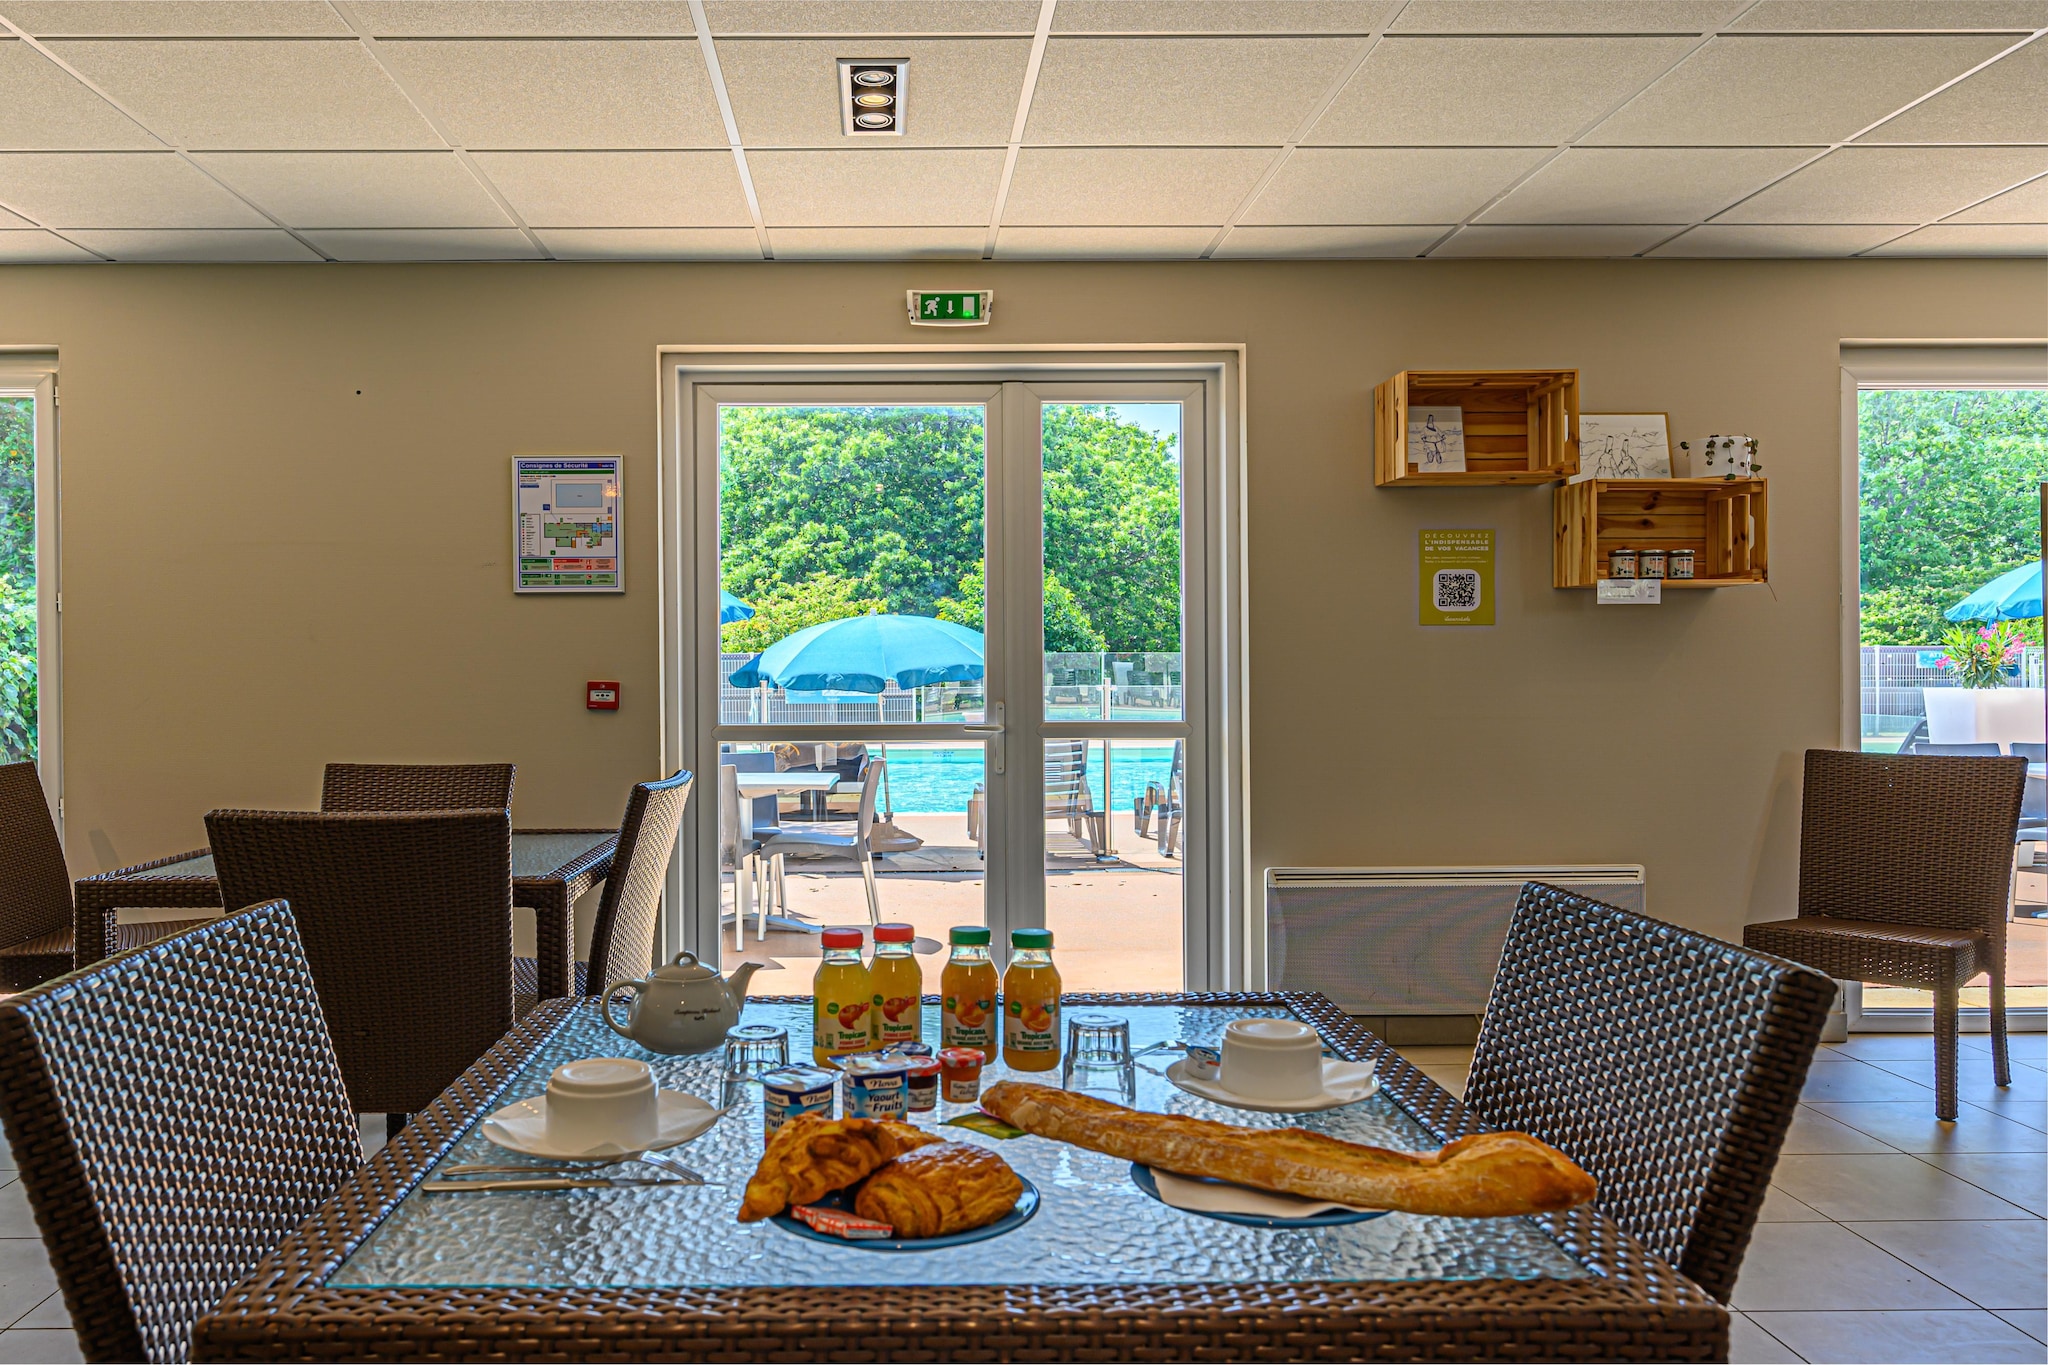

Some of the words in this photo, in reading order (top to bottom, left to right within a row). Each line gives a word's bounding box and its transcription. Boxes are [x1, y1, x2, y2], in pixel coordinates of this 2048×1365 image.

[882, 1022, 913, 1032] Tropicana
[954, 1026, 986, 1036] Tropicana
[838, 1031, 867, 1040] Tropicana
[1020, 1031, 1052, 1040] Tropicana
[868, 1091, 900, 1102] Yaourt
[873, 1101, 903, 1112] Fruits
